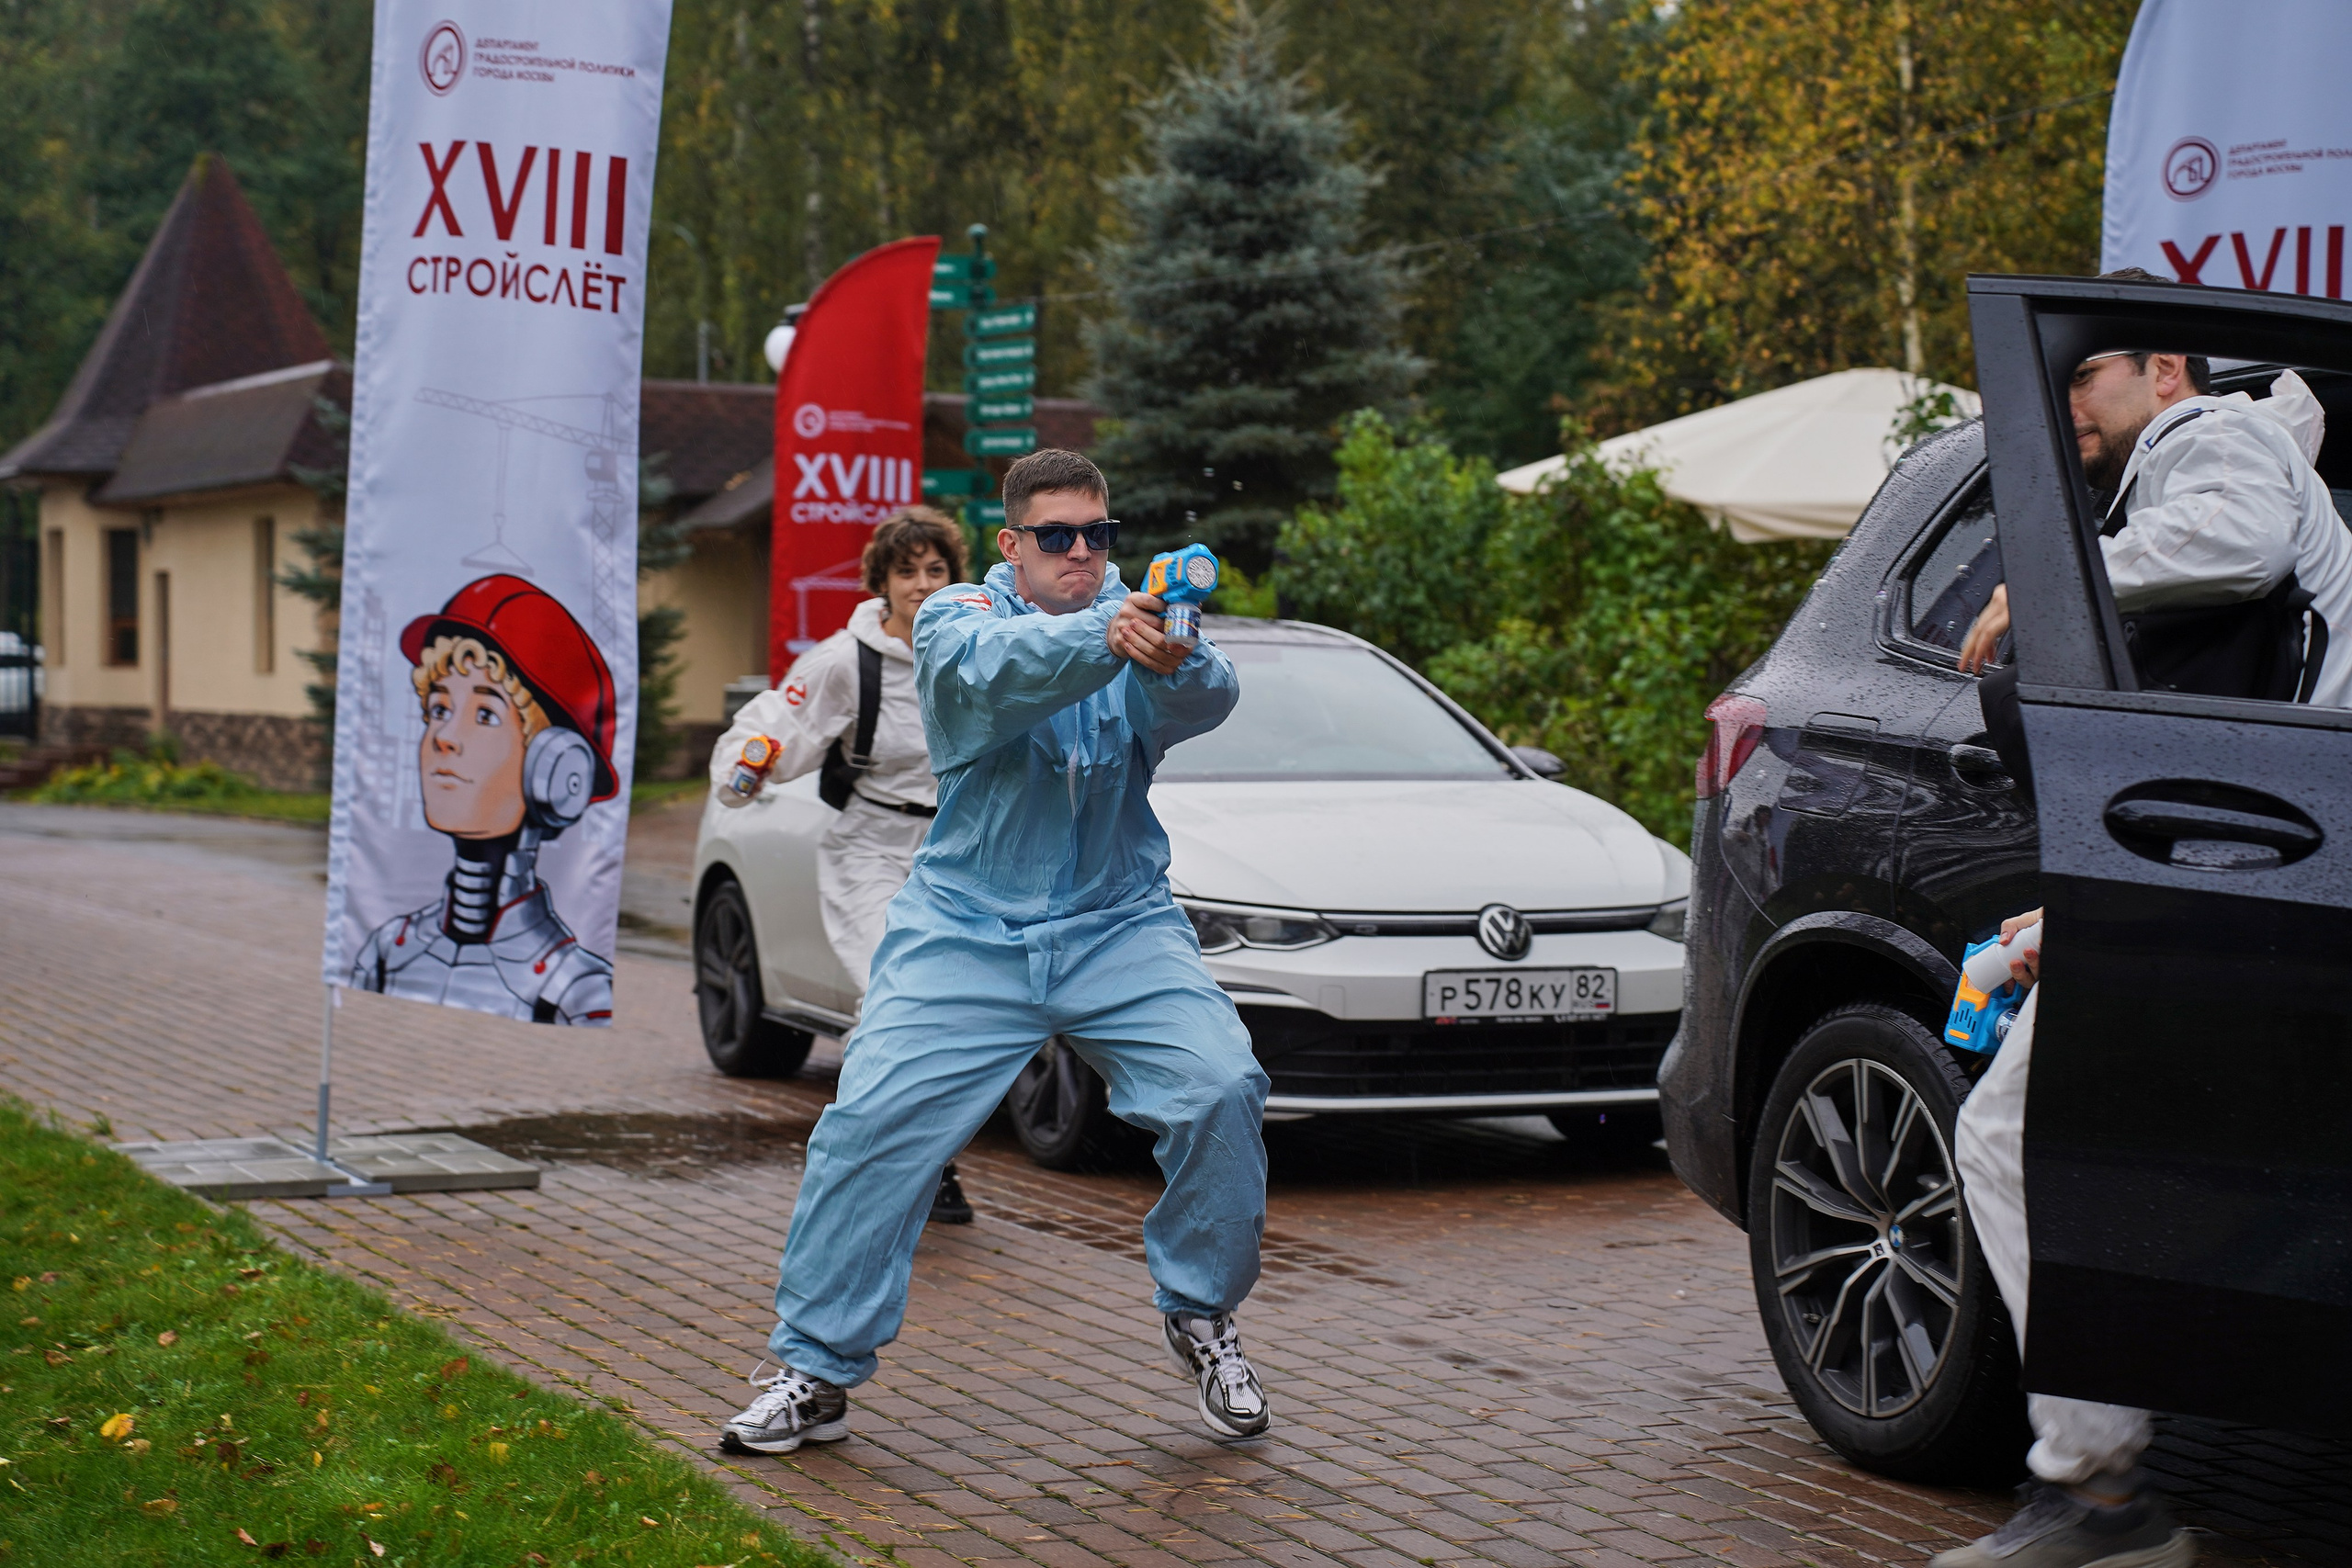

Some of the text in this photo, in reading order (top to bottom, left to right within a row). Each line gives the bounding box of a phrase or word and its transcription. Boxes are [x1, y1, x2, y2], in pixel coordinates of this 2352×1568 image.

[413, 140, 628, 256] XVIII
[407, 251, 628, 313] СТРОЙСЛЁТ
[793, 453, 912, 502] XVIII
[1576, 975, 1605, 998] 82
